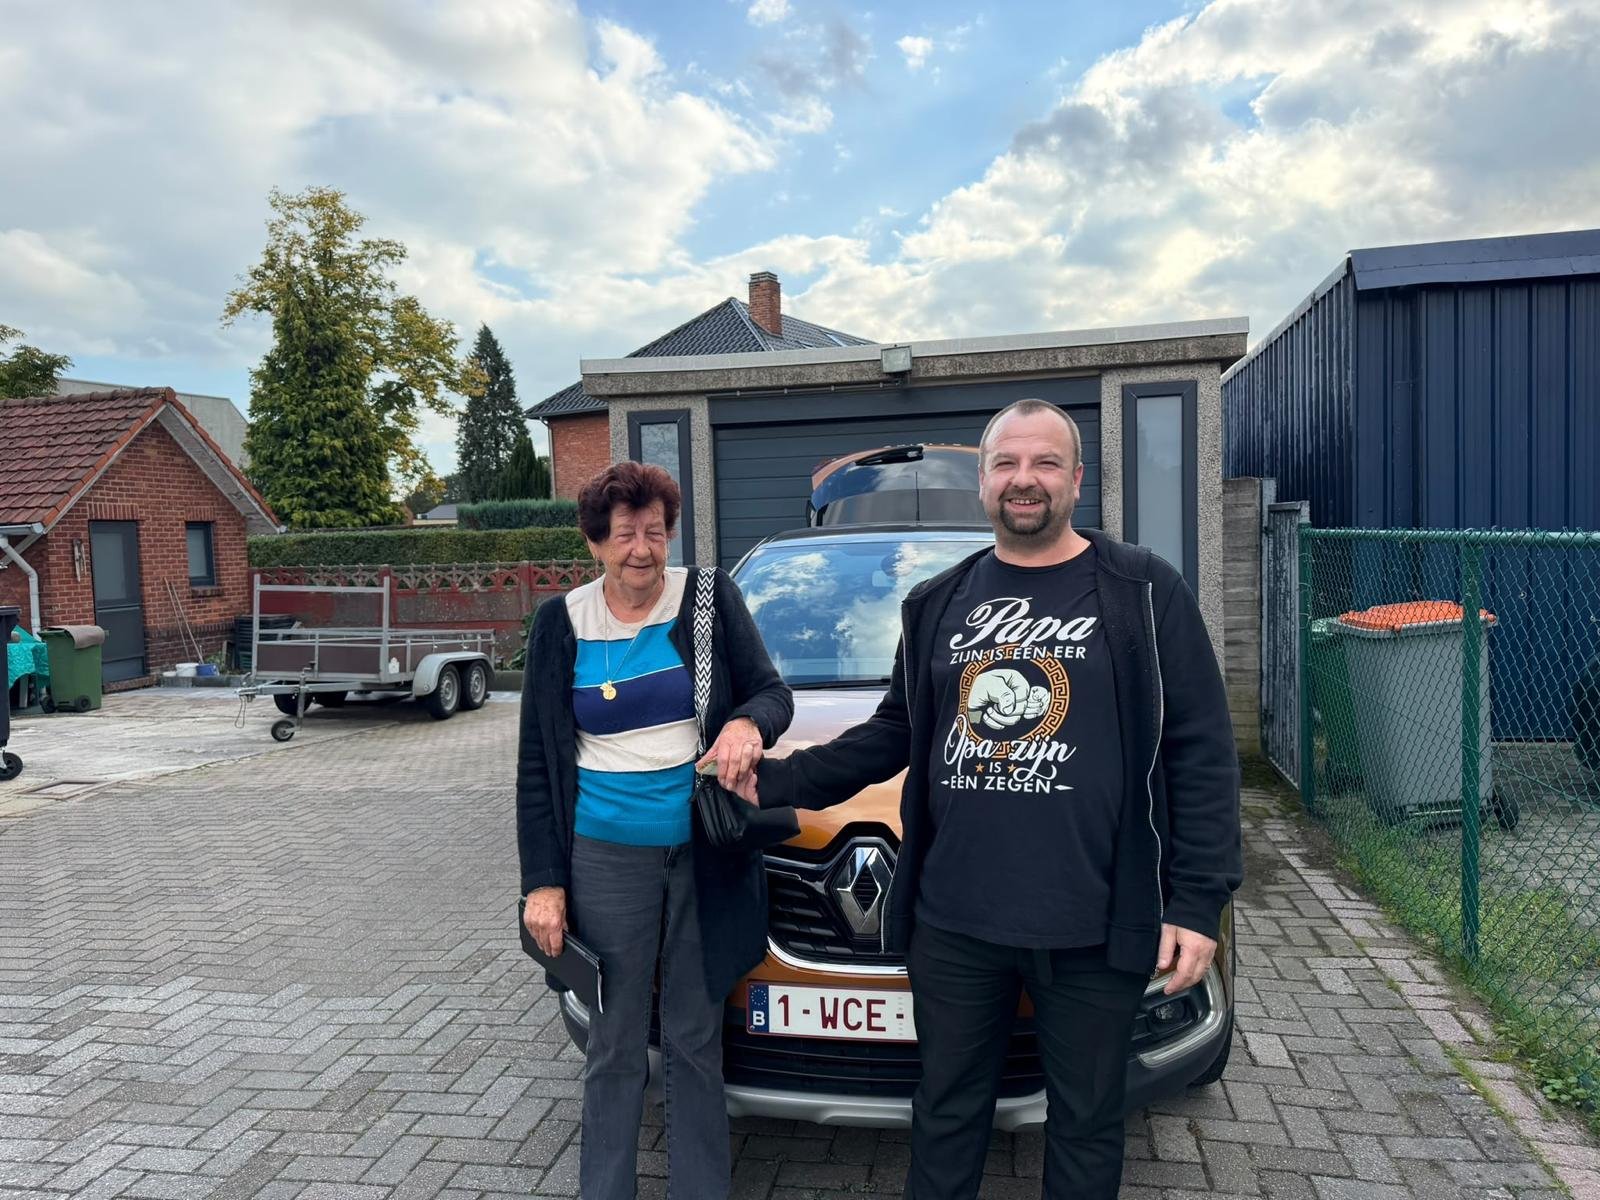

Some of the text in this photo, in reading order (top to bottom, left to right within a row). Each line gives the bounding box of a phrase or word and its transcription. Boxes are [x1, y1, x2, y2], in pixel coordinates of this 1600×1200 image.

[949, 597, 1098, 650] Papa
[950, 646, 1086, 665] ZIJN IS EEN EER
[944, 714, 1076, 782] Opa zijn
[989, 761, 1002, 774] IS
[950, 775, 1051, 794] EEN ZEGEN
[752, 1010, 766, 1026] B
